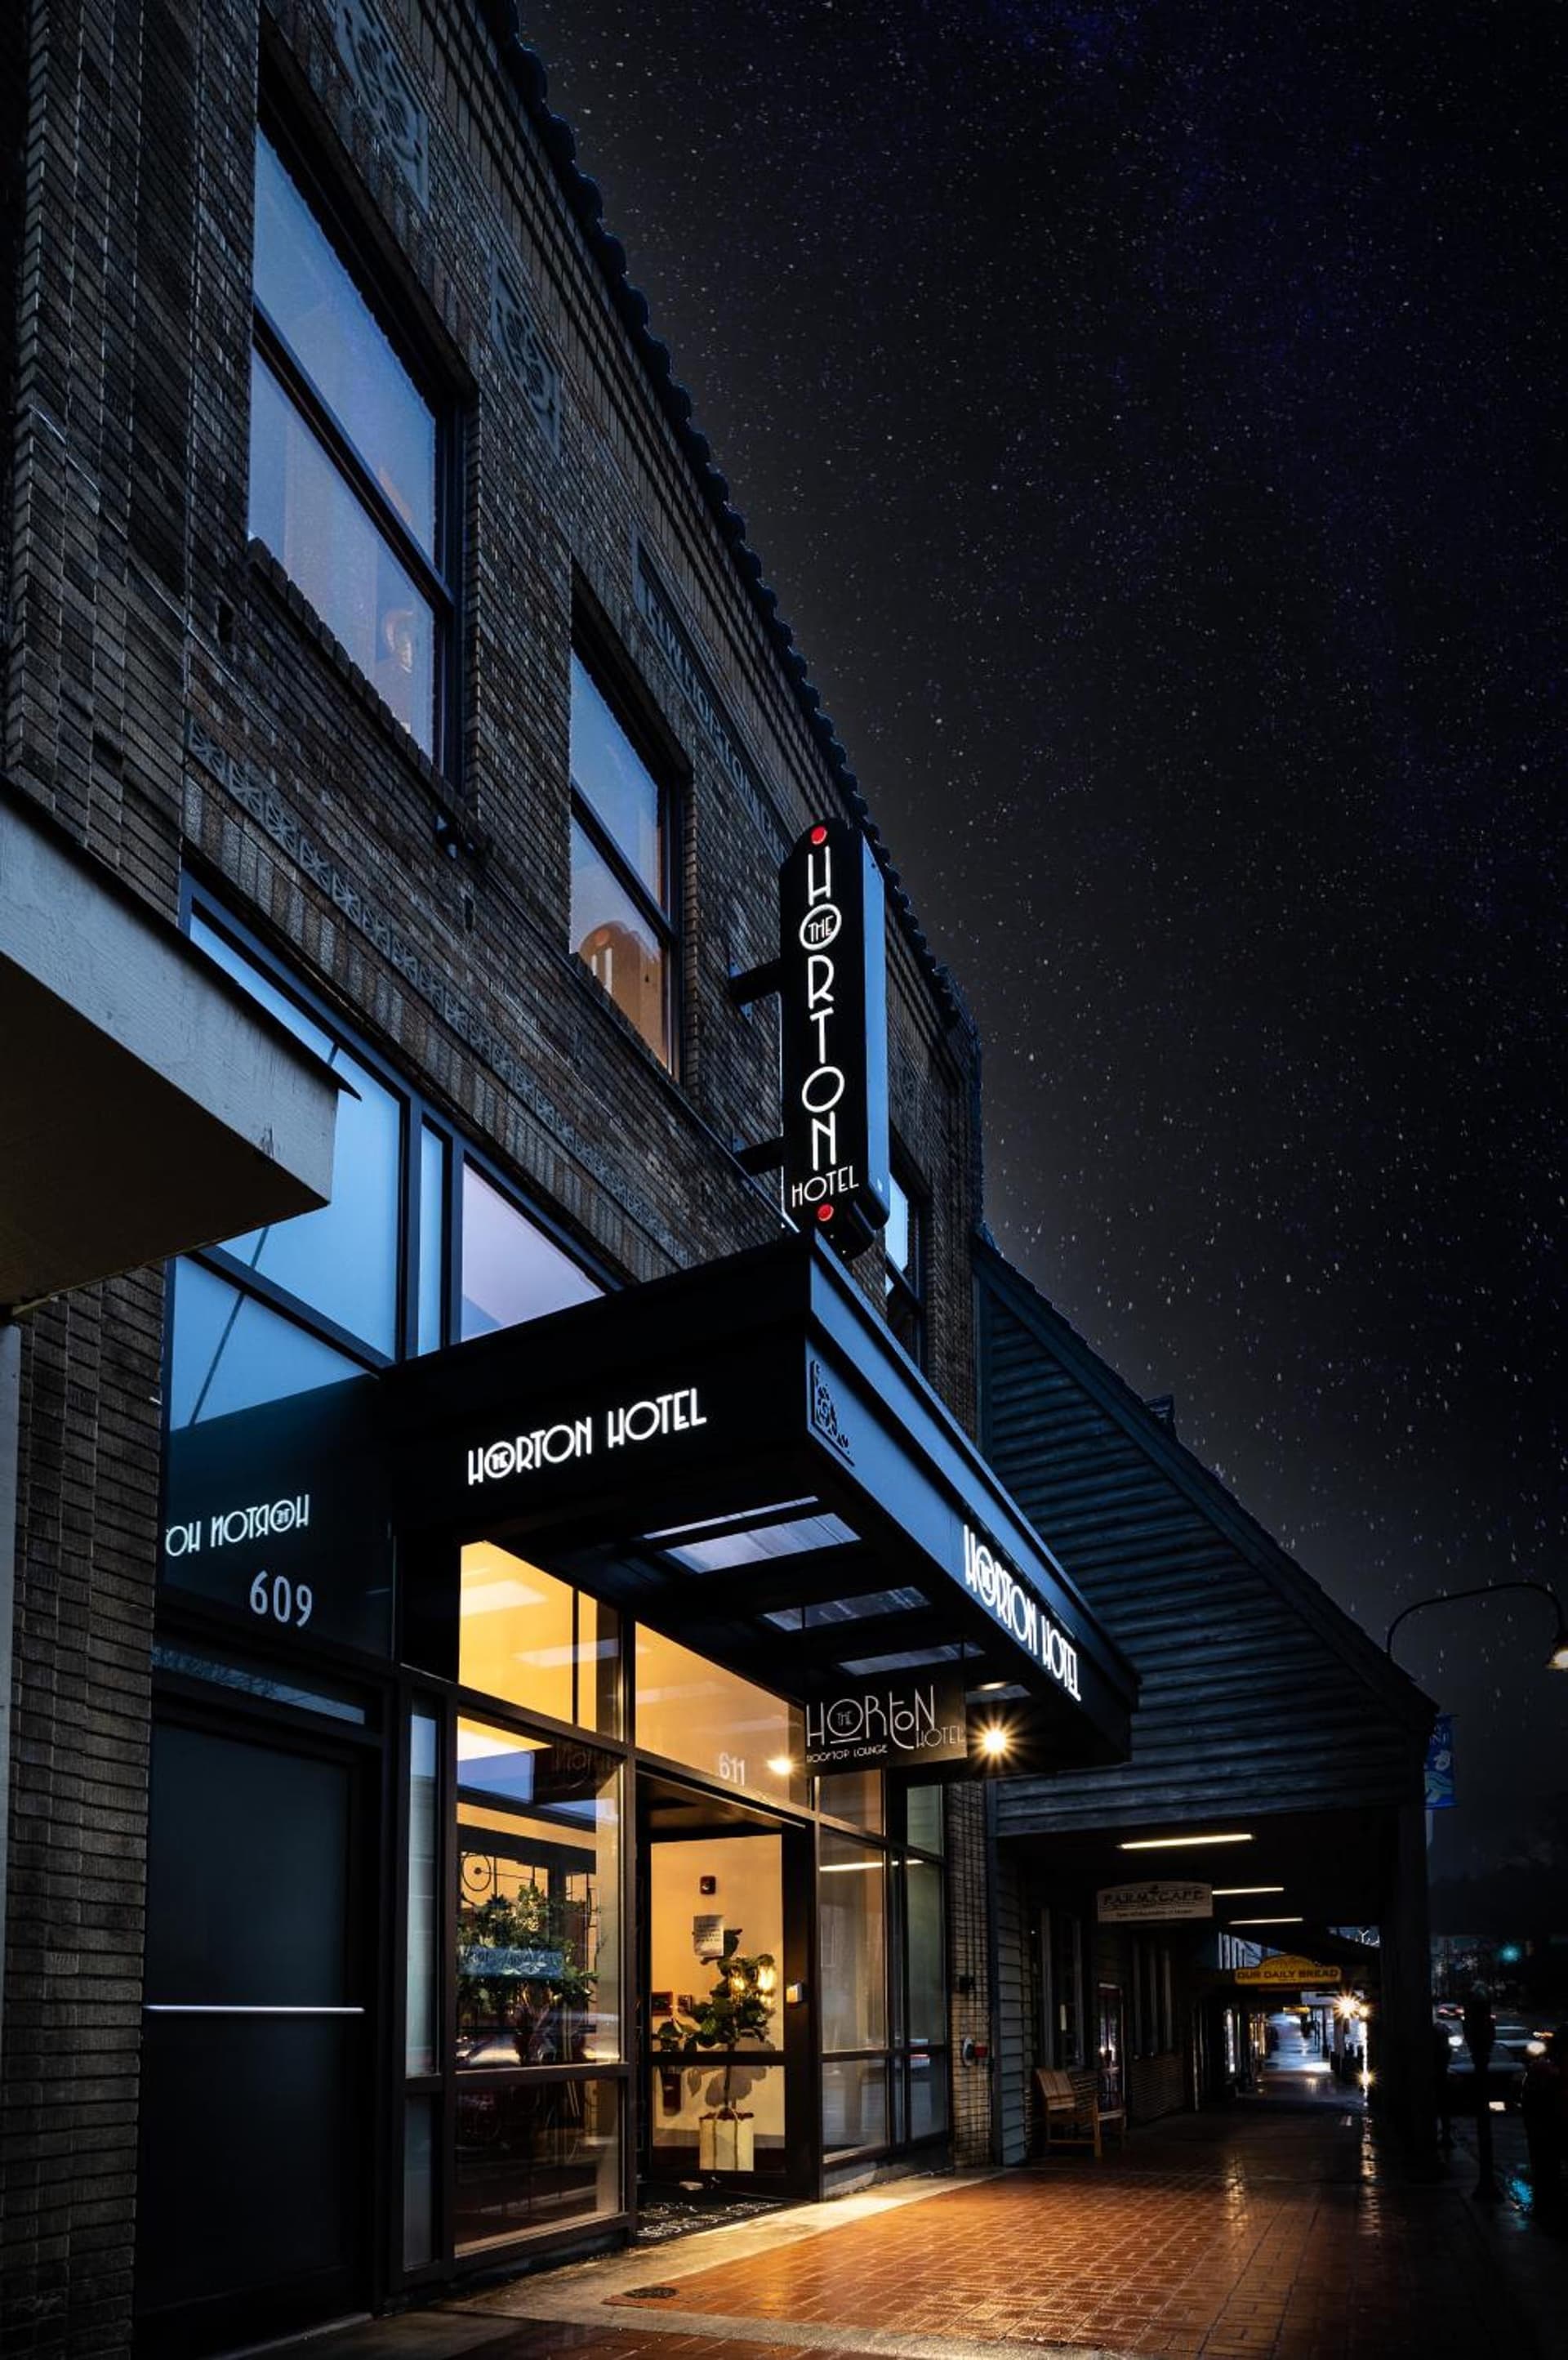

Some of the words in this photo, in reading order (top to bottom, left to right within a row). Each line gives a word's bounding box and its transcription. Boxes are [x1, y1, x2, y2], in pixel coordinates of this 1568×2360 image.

[808, 915, 834, 944] THE
[800, 845, 845, 1171] HORTON
[791, 1165, 859, 1208] HOTEL
[468, 1416, 592, 1486] HORTON
[608, 1387, 707, 1448] HOTEL
[249, 1570, 313, 1627] 609
[964, 1524, 1038, 1656] HORTON
[1040, 1614, 1082, 1702] HOTEL
[805, 1684, 935, 1750] HORTON
[915, 1724, 965, 1750] HOTEL
[719, 1752, 746, 1787] 611
[805, 1749, 850, 1764] ROOFTOP
[853, 1742, 889, 1759] LOUNGE
[1236, 1970, 1261, 1979] OUR
[1263, 1970, 1296, 1979] DAILY
[1298, 1969, 1339, 1979] BREAD
